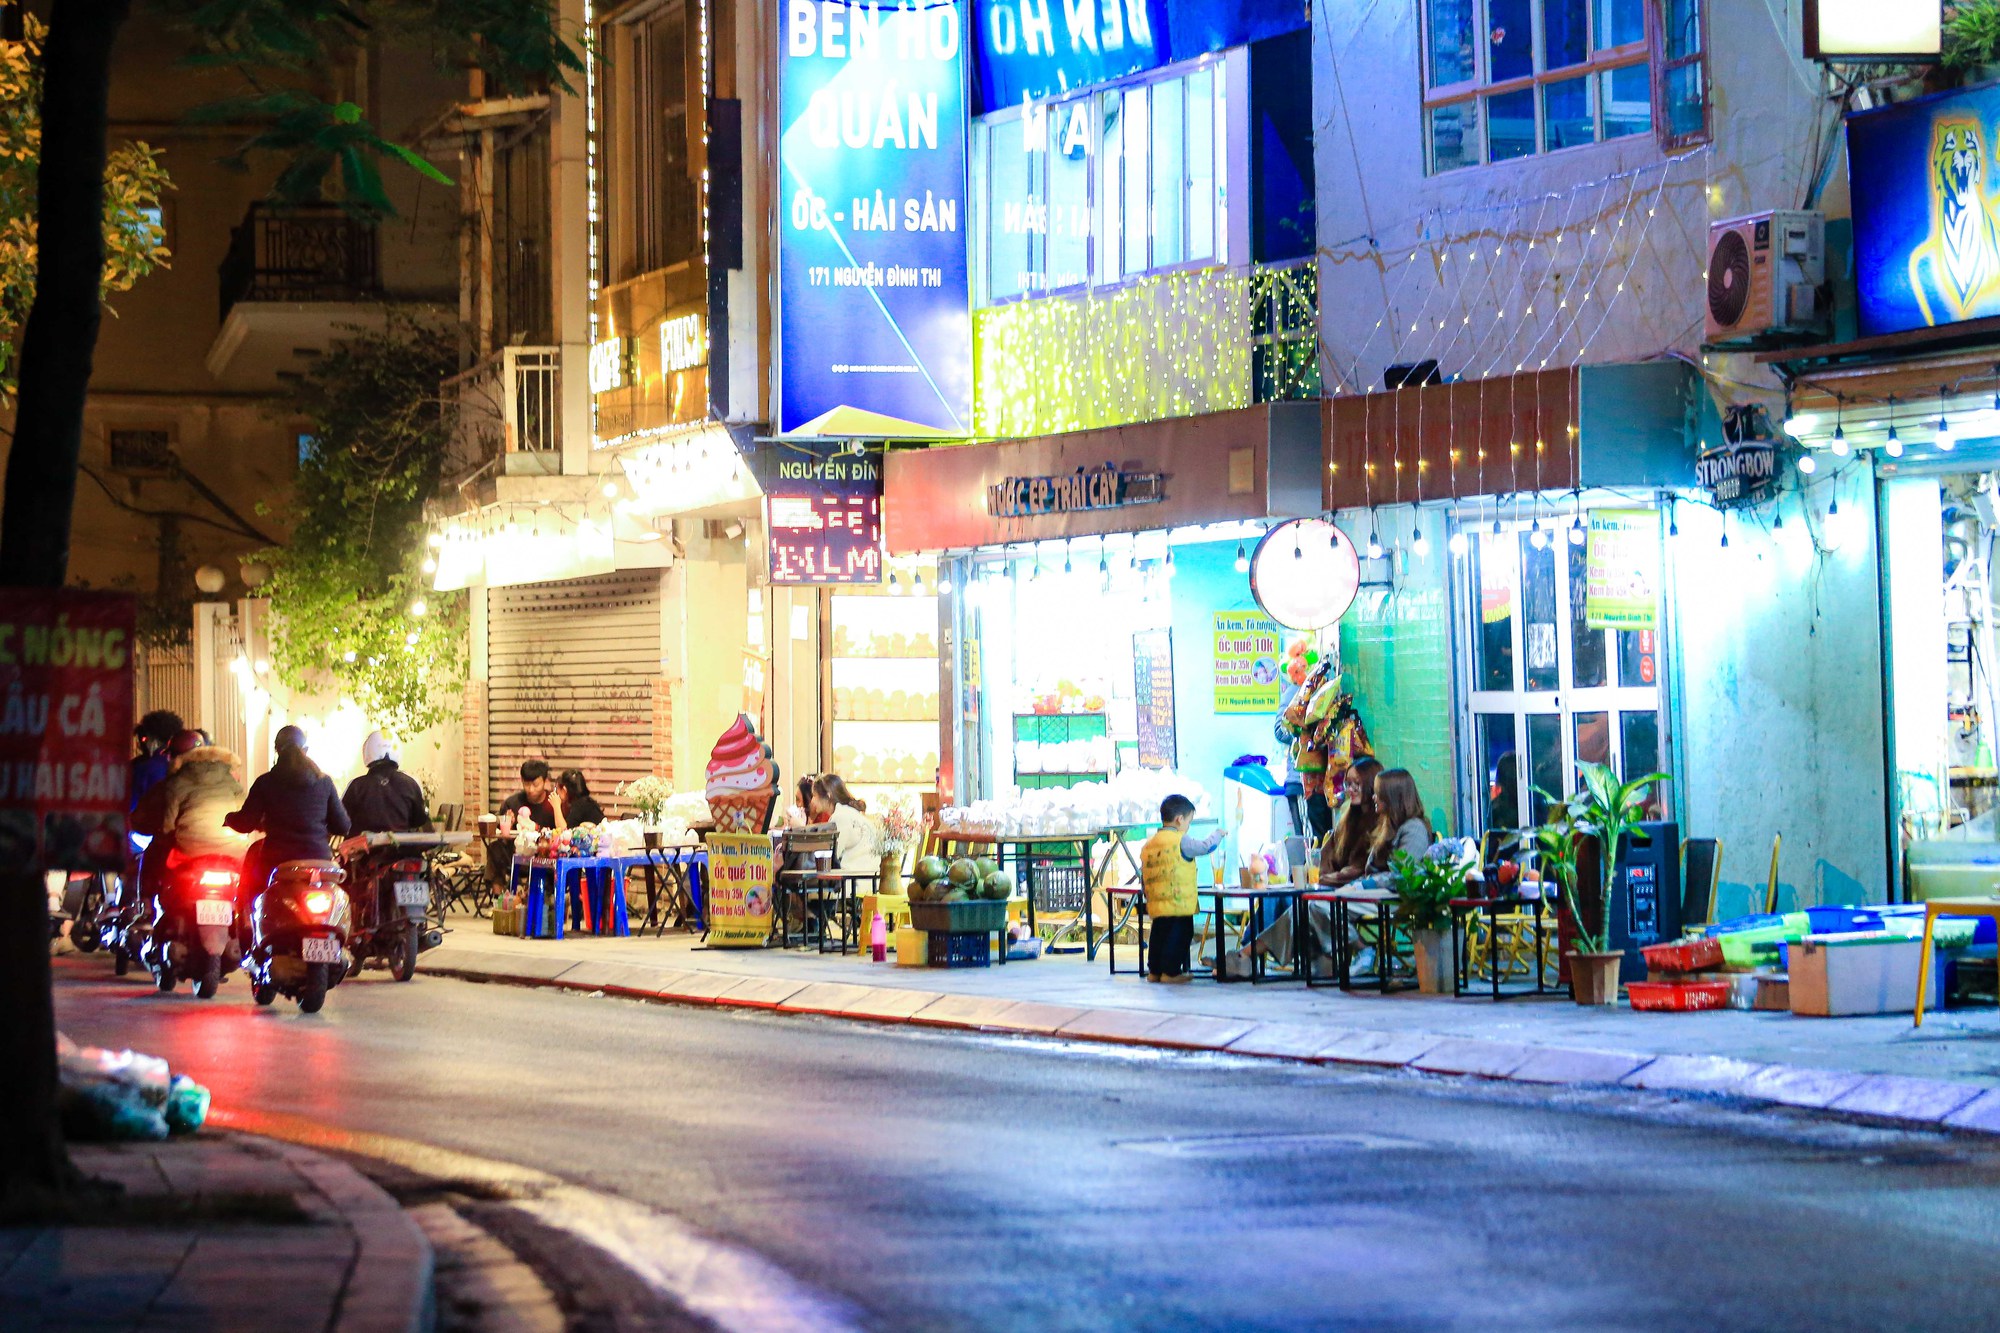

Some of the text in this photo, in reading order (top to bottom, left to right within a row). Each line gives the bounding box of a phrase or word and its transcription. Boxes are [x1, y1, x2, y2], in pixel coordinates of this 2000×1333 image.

[808, 78, 938, 150] QUÁN
[853, 188, 896, 231] HẢI
[904, 189, 956, 231] SẢN
[808, 266, 830, 286] 171
[887, 264, 918, 287] ĐÌNH
[921, 268, 941, 287] THI
[852, 459, 883, 480] ĐÌN
[1695, 450, 1774, 487] STRONGBOW
[1255, 638, 1273, 652] 10k
[59, 681, 106, 736] CÁ
[714, 860, 767, 881] ốc quế 10k
